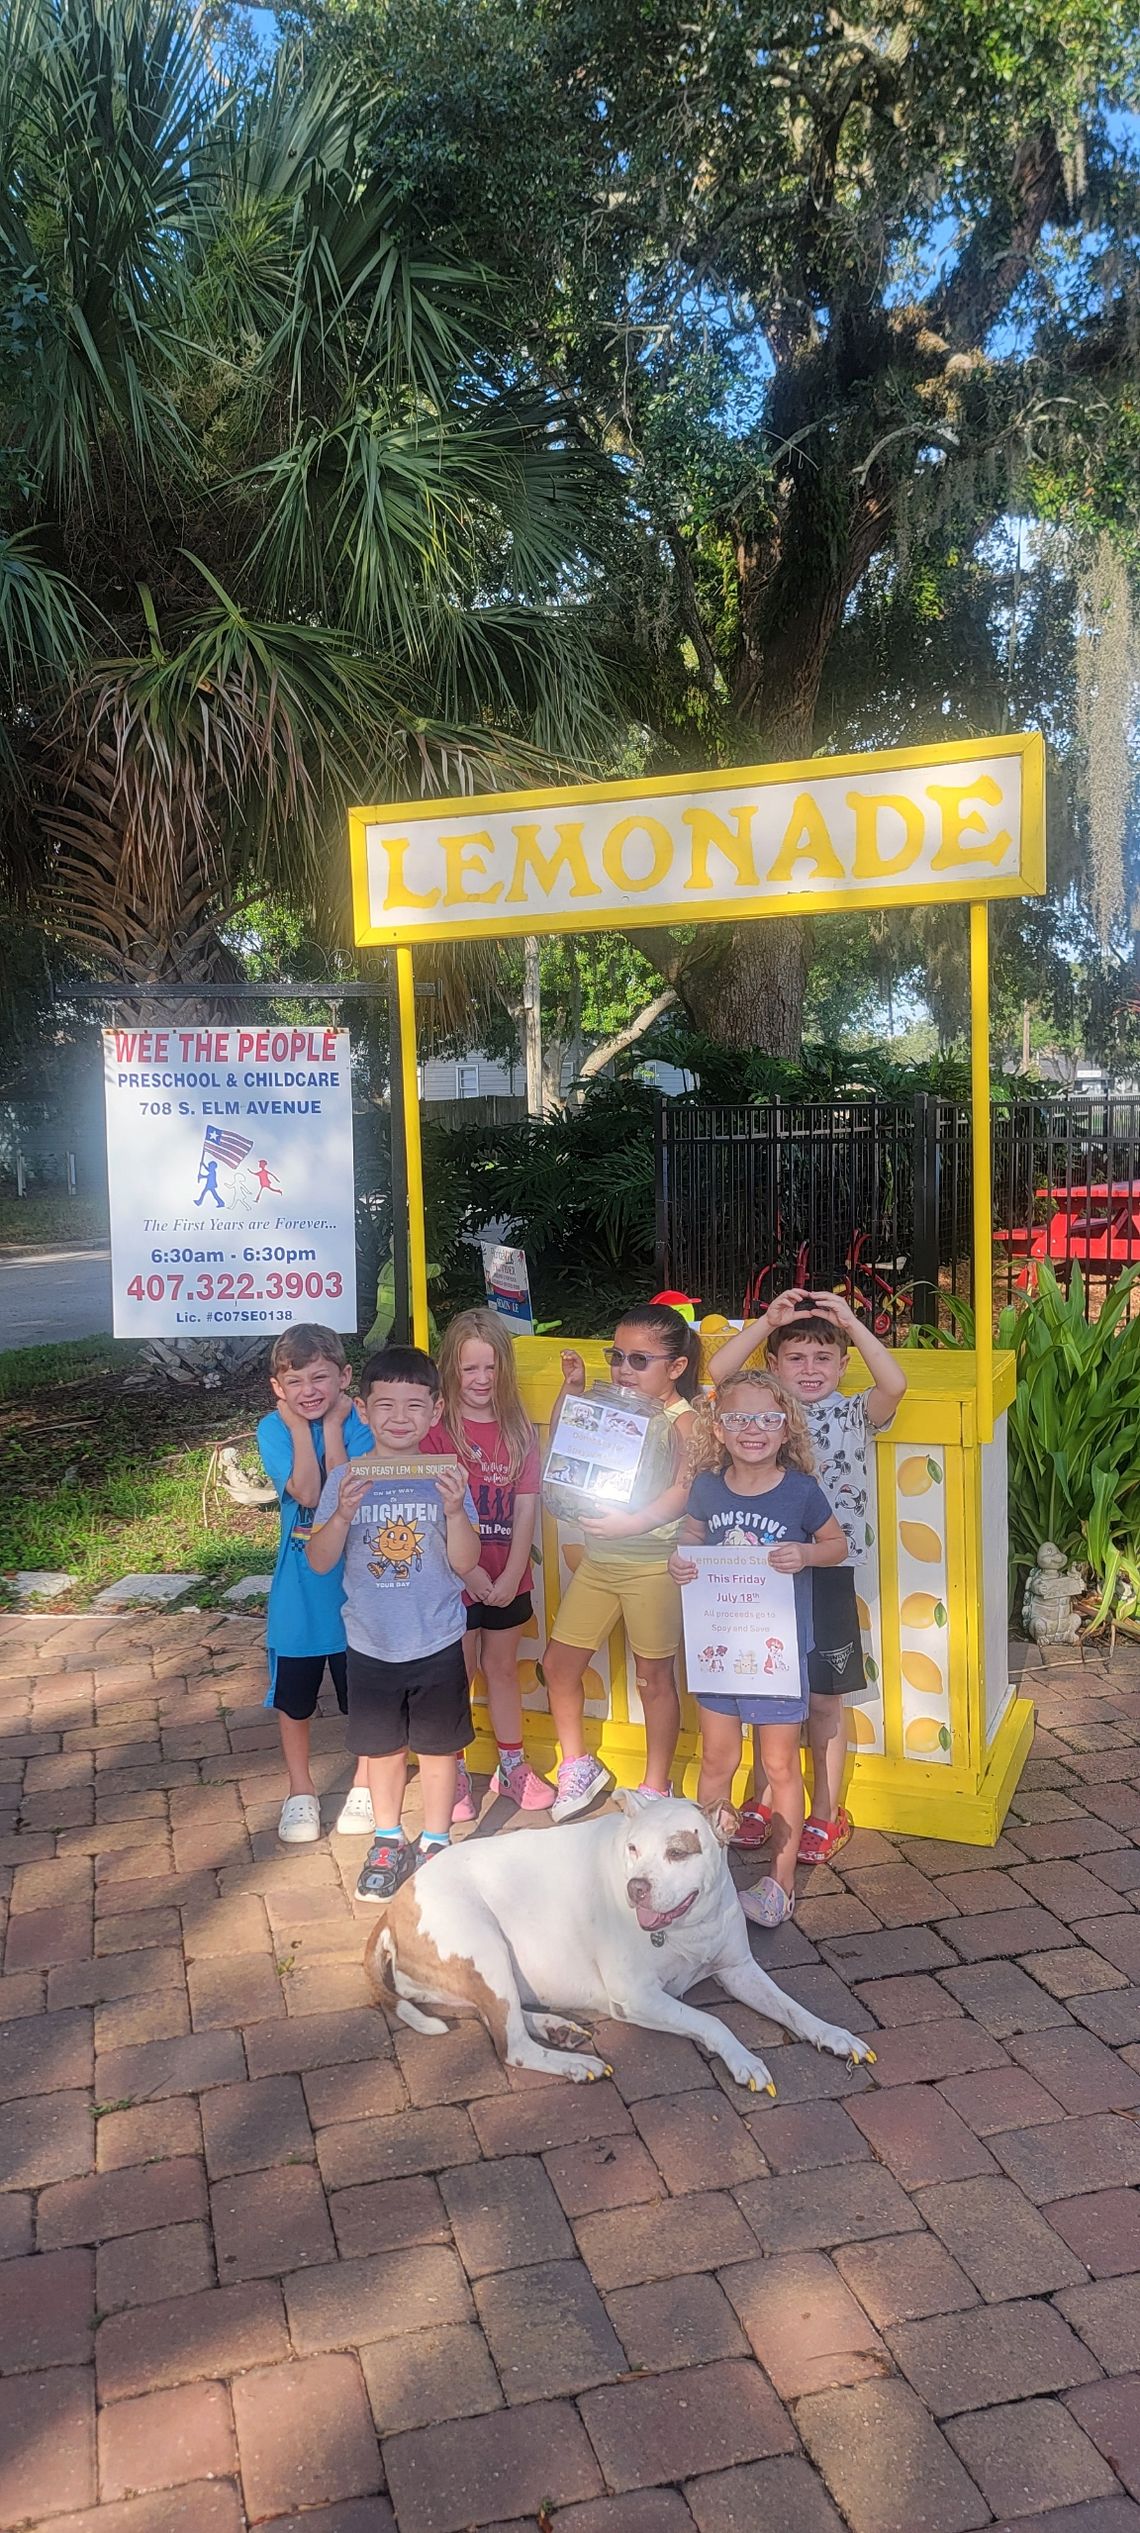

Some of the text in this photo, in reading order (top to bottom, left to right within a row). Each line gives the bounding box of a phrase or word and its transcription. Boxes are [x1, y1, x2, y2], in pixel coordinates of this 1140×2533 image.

[381, 774, 1012, 911] LEMONADE
[114, 1032, 337, 1063] WEE THE PEOPLE
[117, 1072, 340, 1088] PRESCHOOL & CHILDCARE
[139, 1100, 322, 1116] 708 S. ELM AVENUE
[143, 1217, 337, 1232] The First Years are Forever...
[151, 1249, 224, 1264] 6:30am
[242, 1247, 317, 1264] 6:30pm
[127, 1271, 343, 1301] 407.322.3903
[176, 1310, 293, 1323] Lic. #C07SE0138
[352, 1466, 370, 1476] EASY
[372, 1465, 394, 1476] PEASY
[493, 1524, 512, 1535] Peo
[708, 1511, 787, 1538] PAWSITIVE
[707, 1574, 766, 1586] This Friday
[716, 1592, 760, 1603] July 18th
[716, 1610, 754, 1619] proceeds
[756, 1612, 766, 1620] go
[767, 1611, 776, 1619] to
[711, 1623, 770, 1633] Spay and Save
